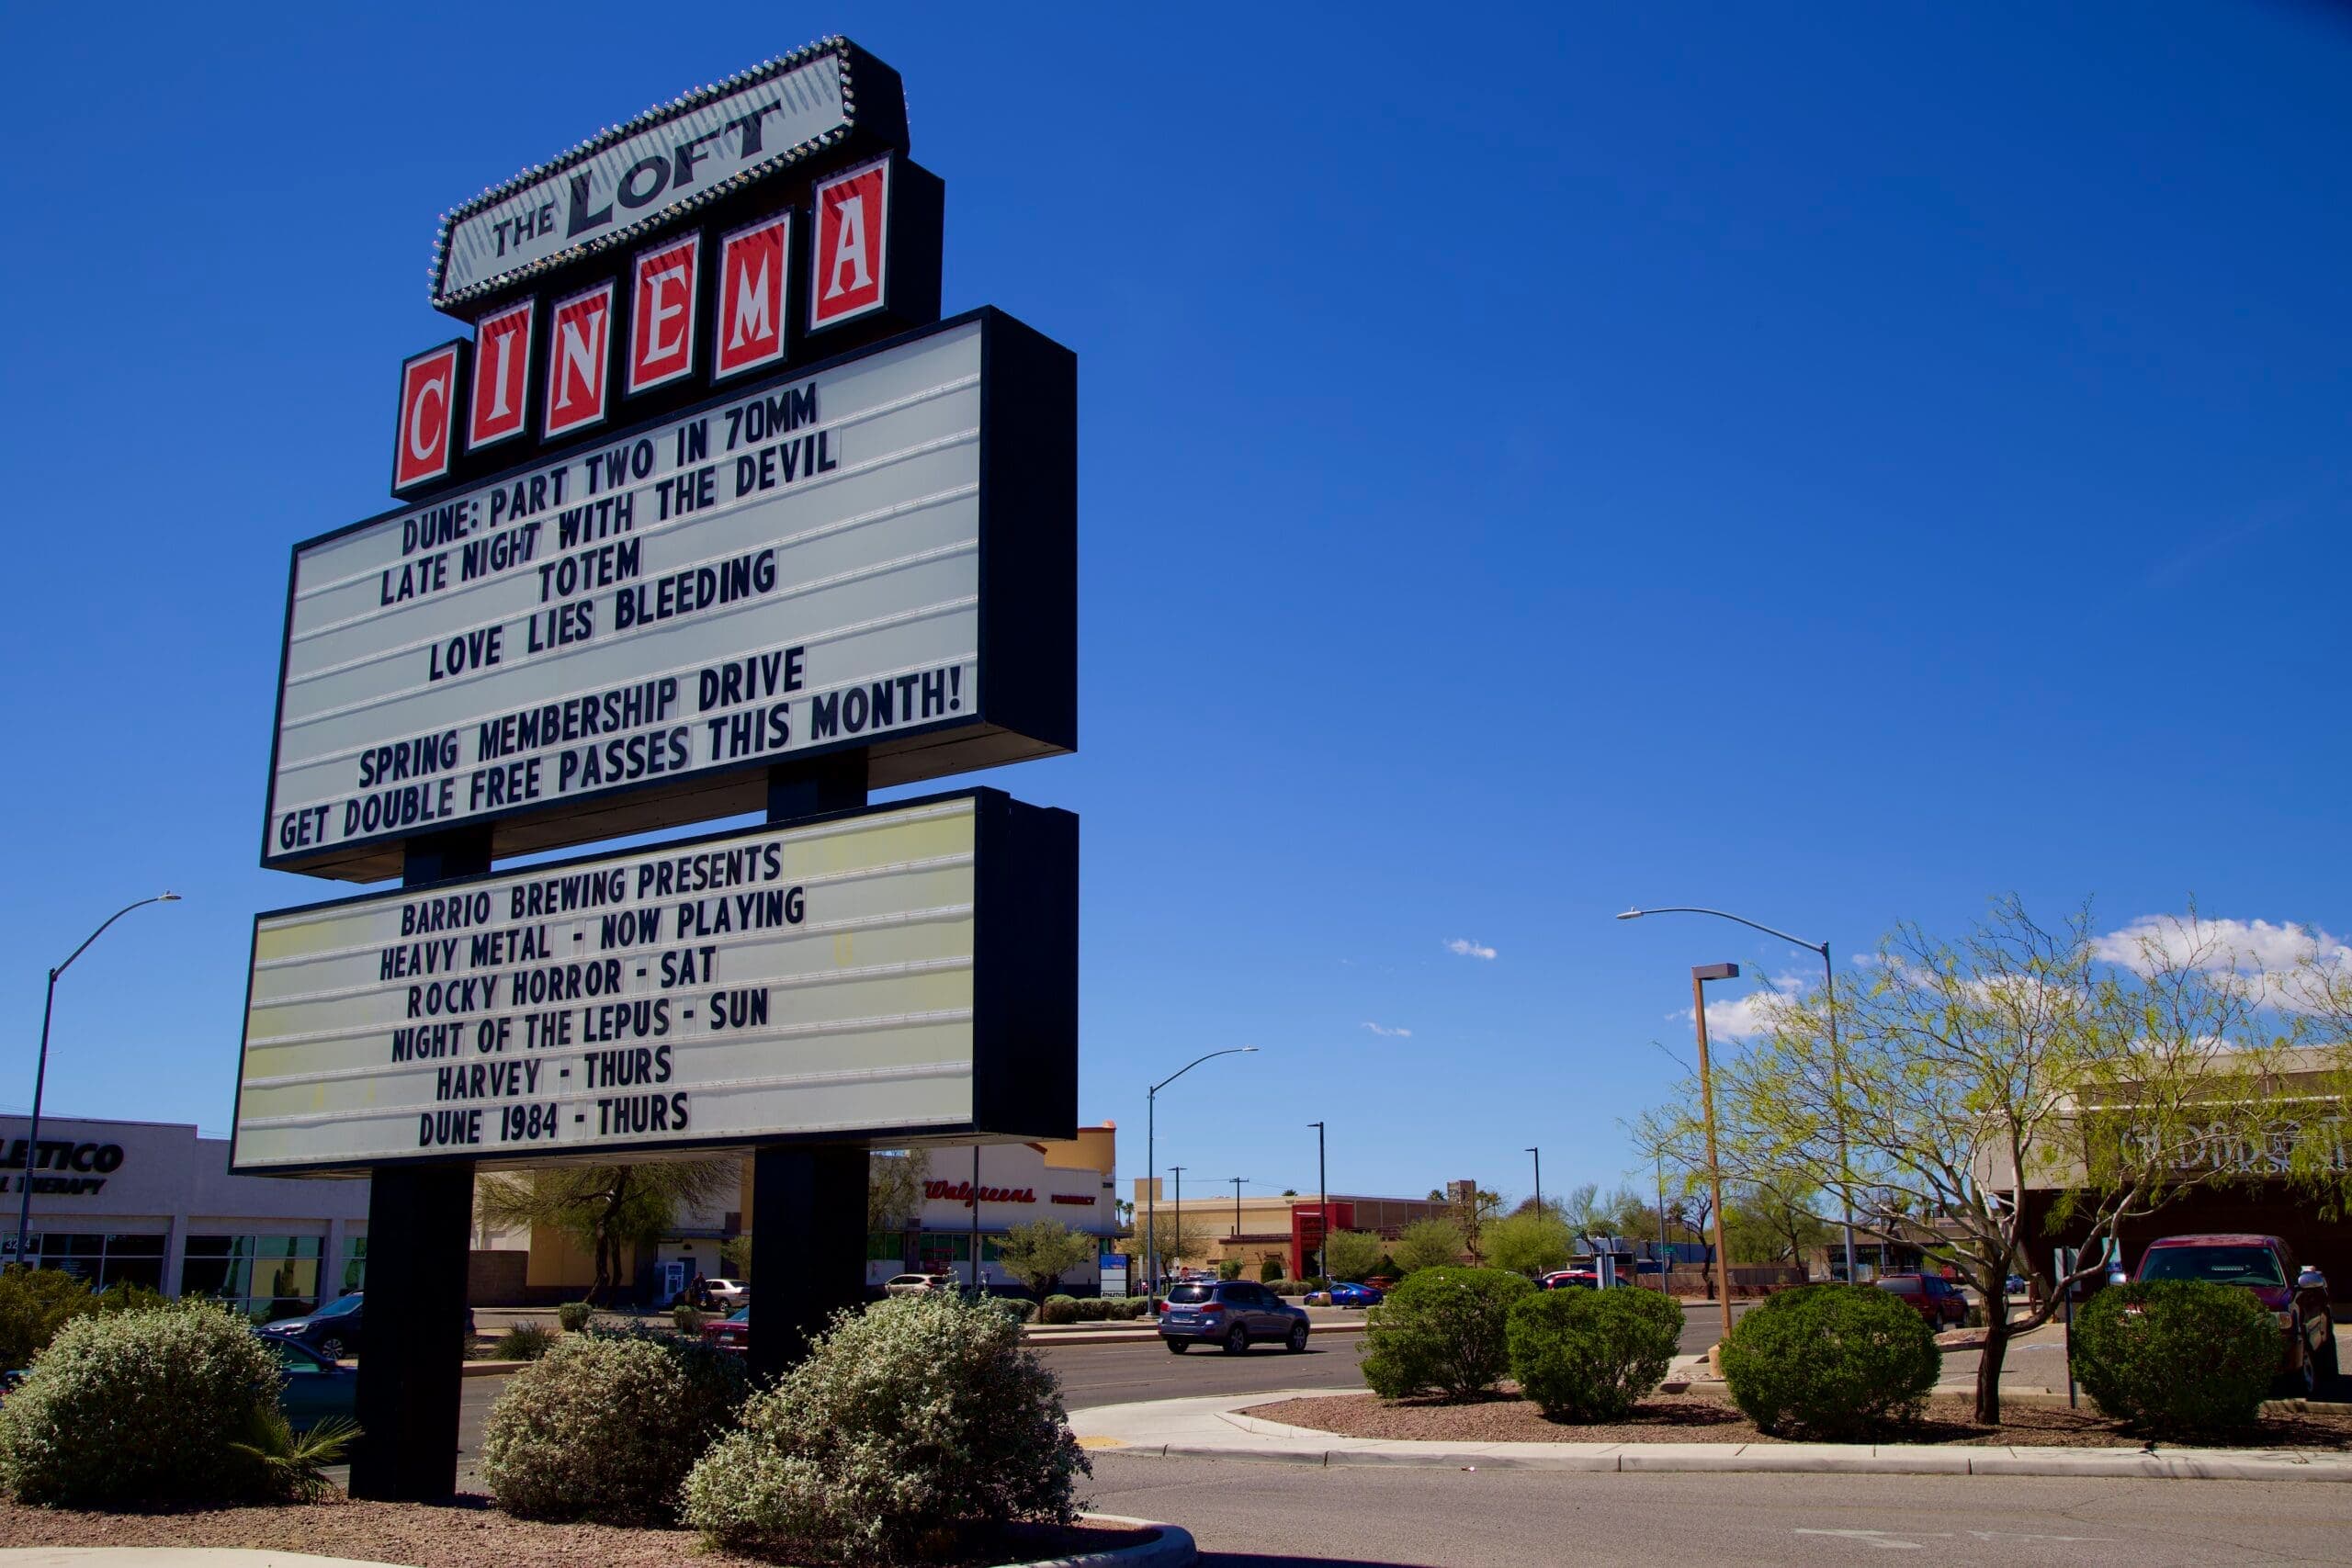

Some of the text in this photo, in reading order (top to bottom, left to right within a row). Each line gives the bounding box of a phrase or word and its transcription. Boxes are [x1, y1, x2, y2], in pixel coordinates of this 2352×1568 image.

[492, 97, 781, 258] THE LOFT
[410, 193, 874, 460] CINEMA
[402, 382, 816, 556] DUNE: PART TWO IN 70MM
[380, 431, 836, 606] LATE NIGHT WITH THE DEVIL
[429, 549, 775, 682] LOVE LIES BLEEDING
[538, 536, 640, 603] TOTEM
[280, 665, 961, 850] GET DOUBLE FREE PASSES THIS MONTH!
[358, 646, 805, 788] SPRING MEMBERSHIP DRIVE
[379, 886, 805, 980] HEAVY METAL - NOW PLAYING
[401, 842, 781, 937] BARRIO BREWING PRESENTS
[391, 987, 768, 1063] NIGHT OF THE LEPUS - SUN
[407, 945, 716, 1019] ROCKY HORROR - SAT
[419, 1092, 688, 1146] DUNE 1984 - THURS
[436, 1045, 671, 1101] HARVEY - THURS
[923, 1180, 1036, 1208] Walgreens
[6, 1237, 30, 1250] 324
